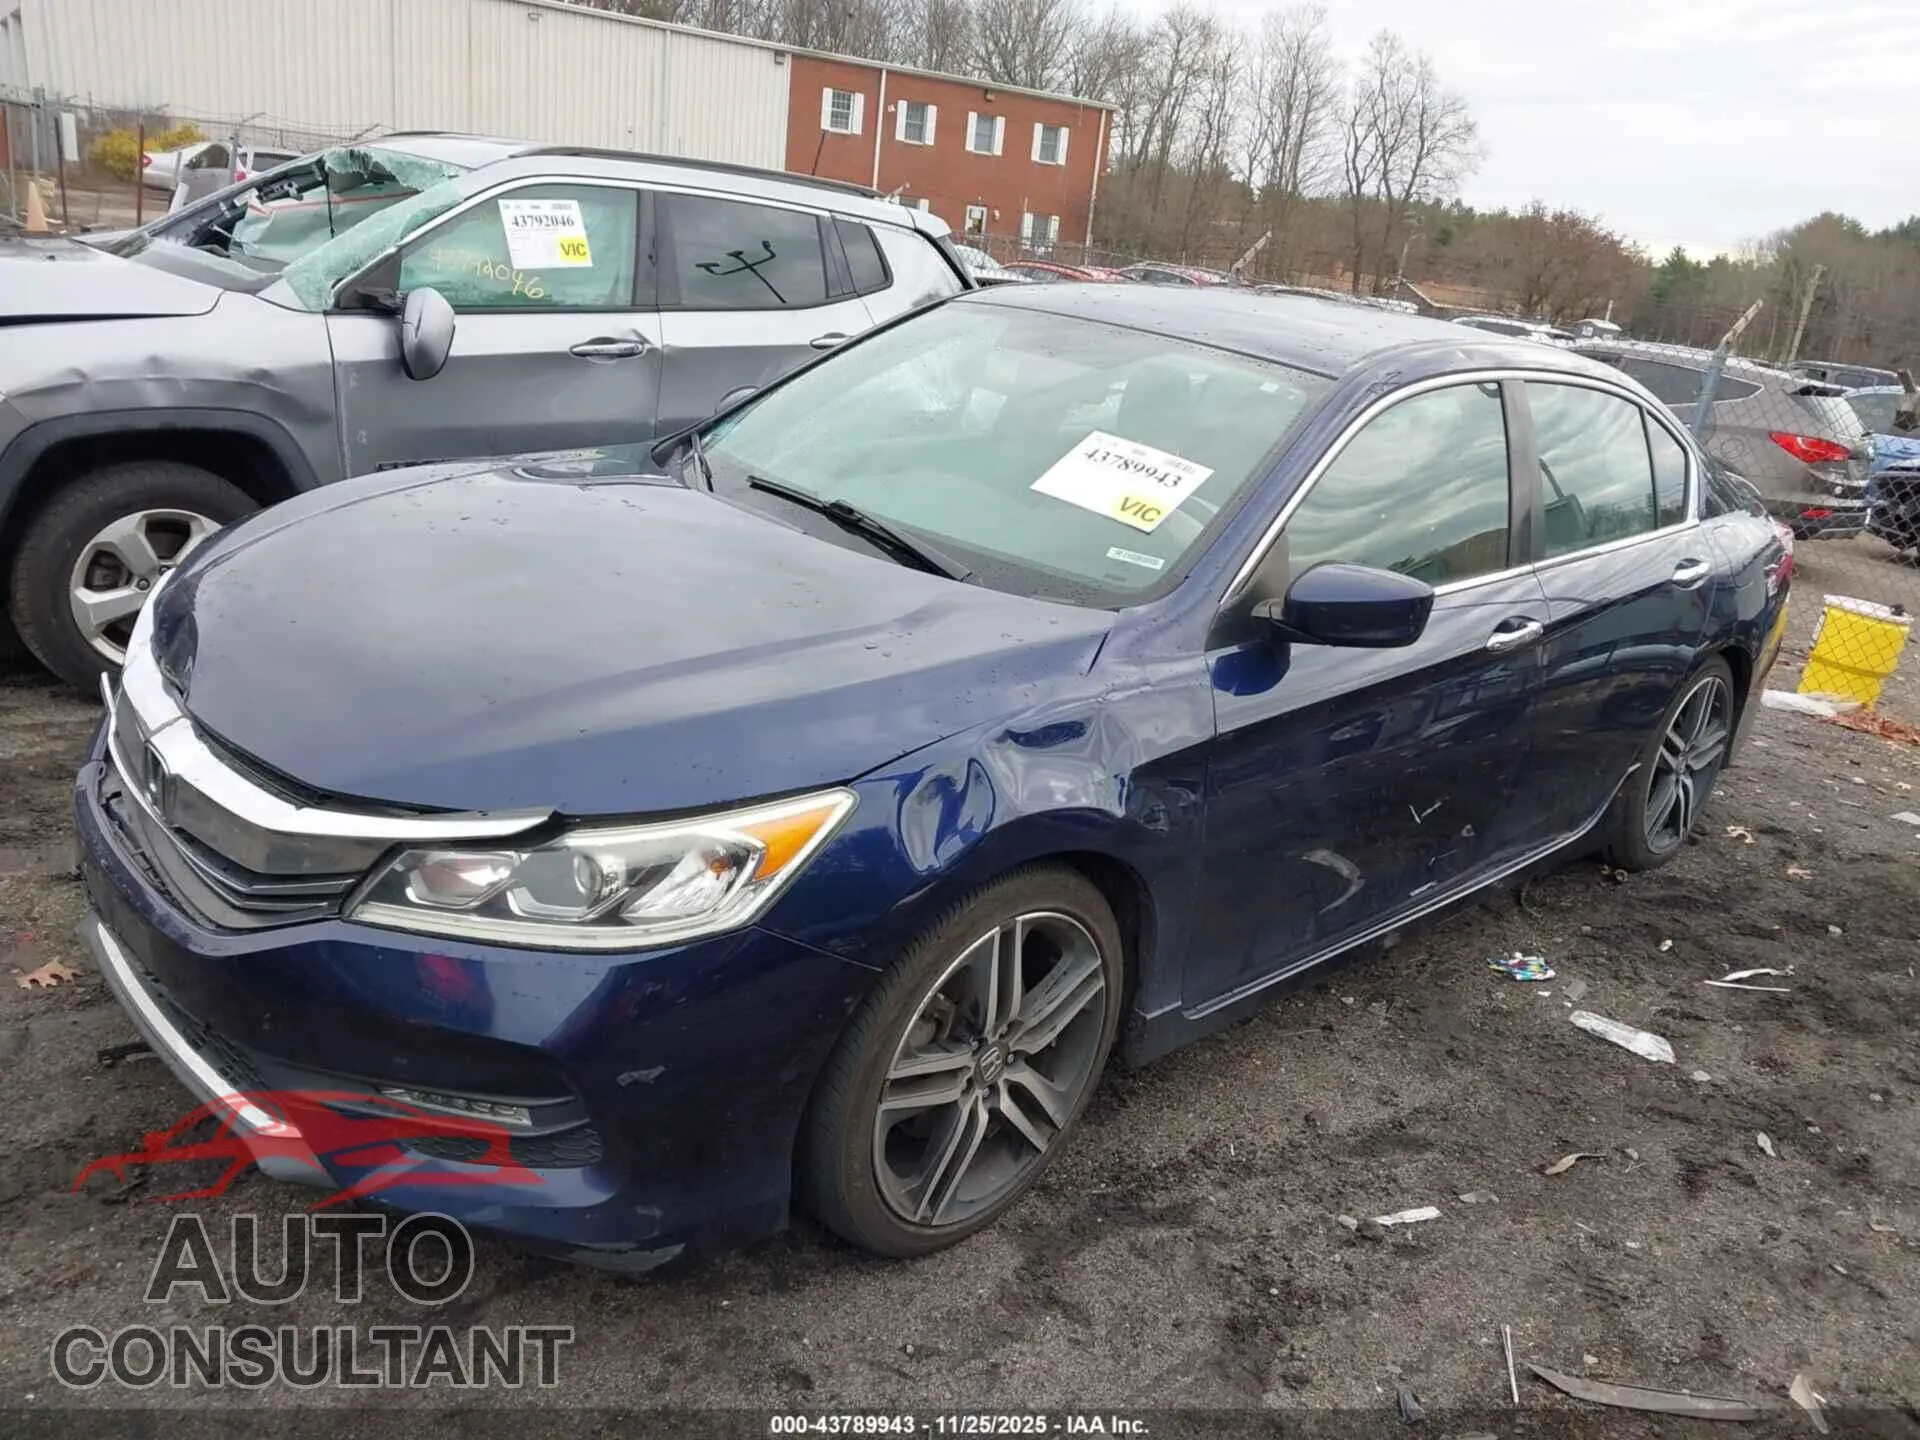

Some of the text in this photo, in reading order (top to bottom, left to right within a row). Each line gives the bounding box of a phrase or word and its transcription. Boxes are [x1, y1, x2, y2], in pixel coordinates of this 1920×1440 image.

[511, 214, 575, 228] 43792046
[560, 242, 587, 258] VIC
[1084, 447, 1182, 488] 43789943
[1119, 496, 1161, 522] VIC
